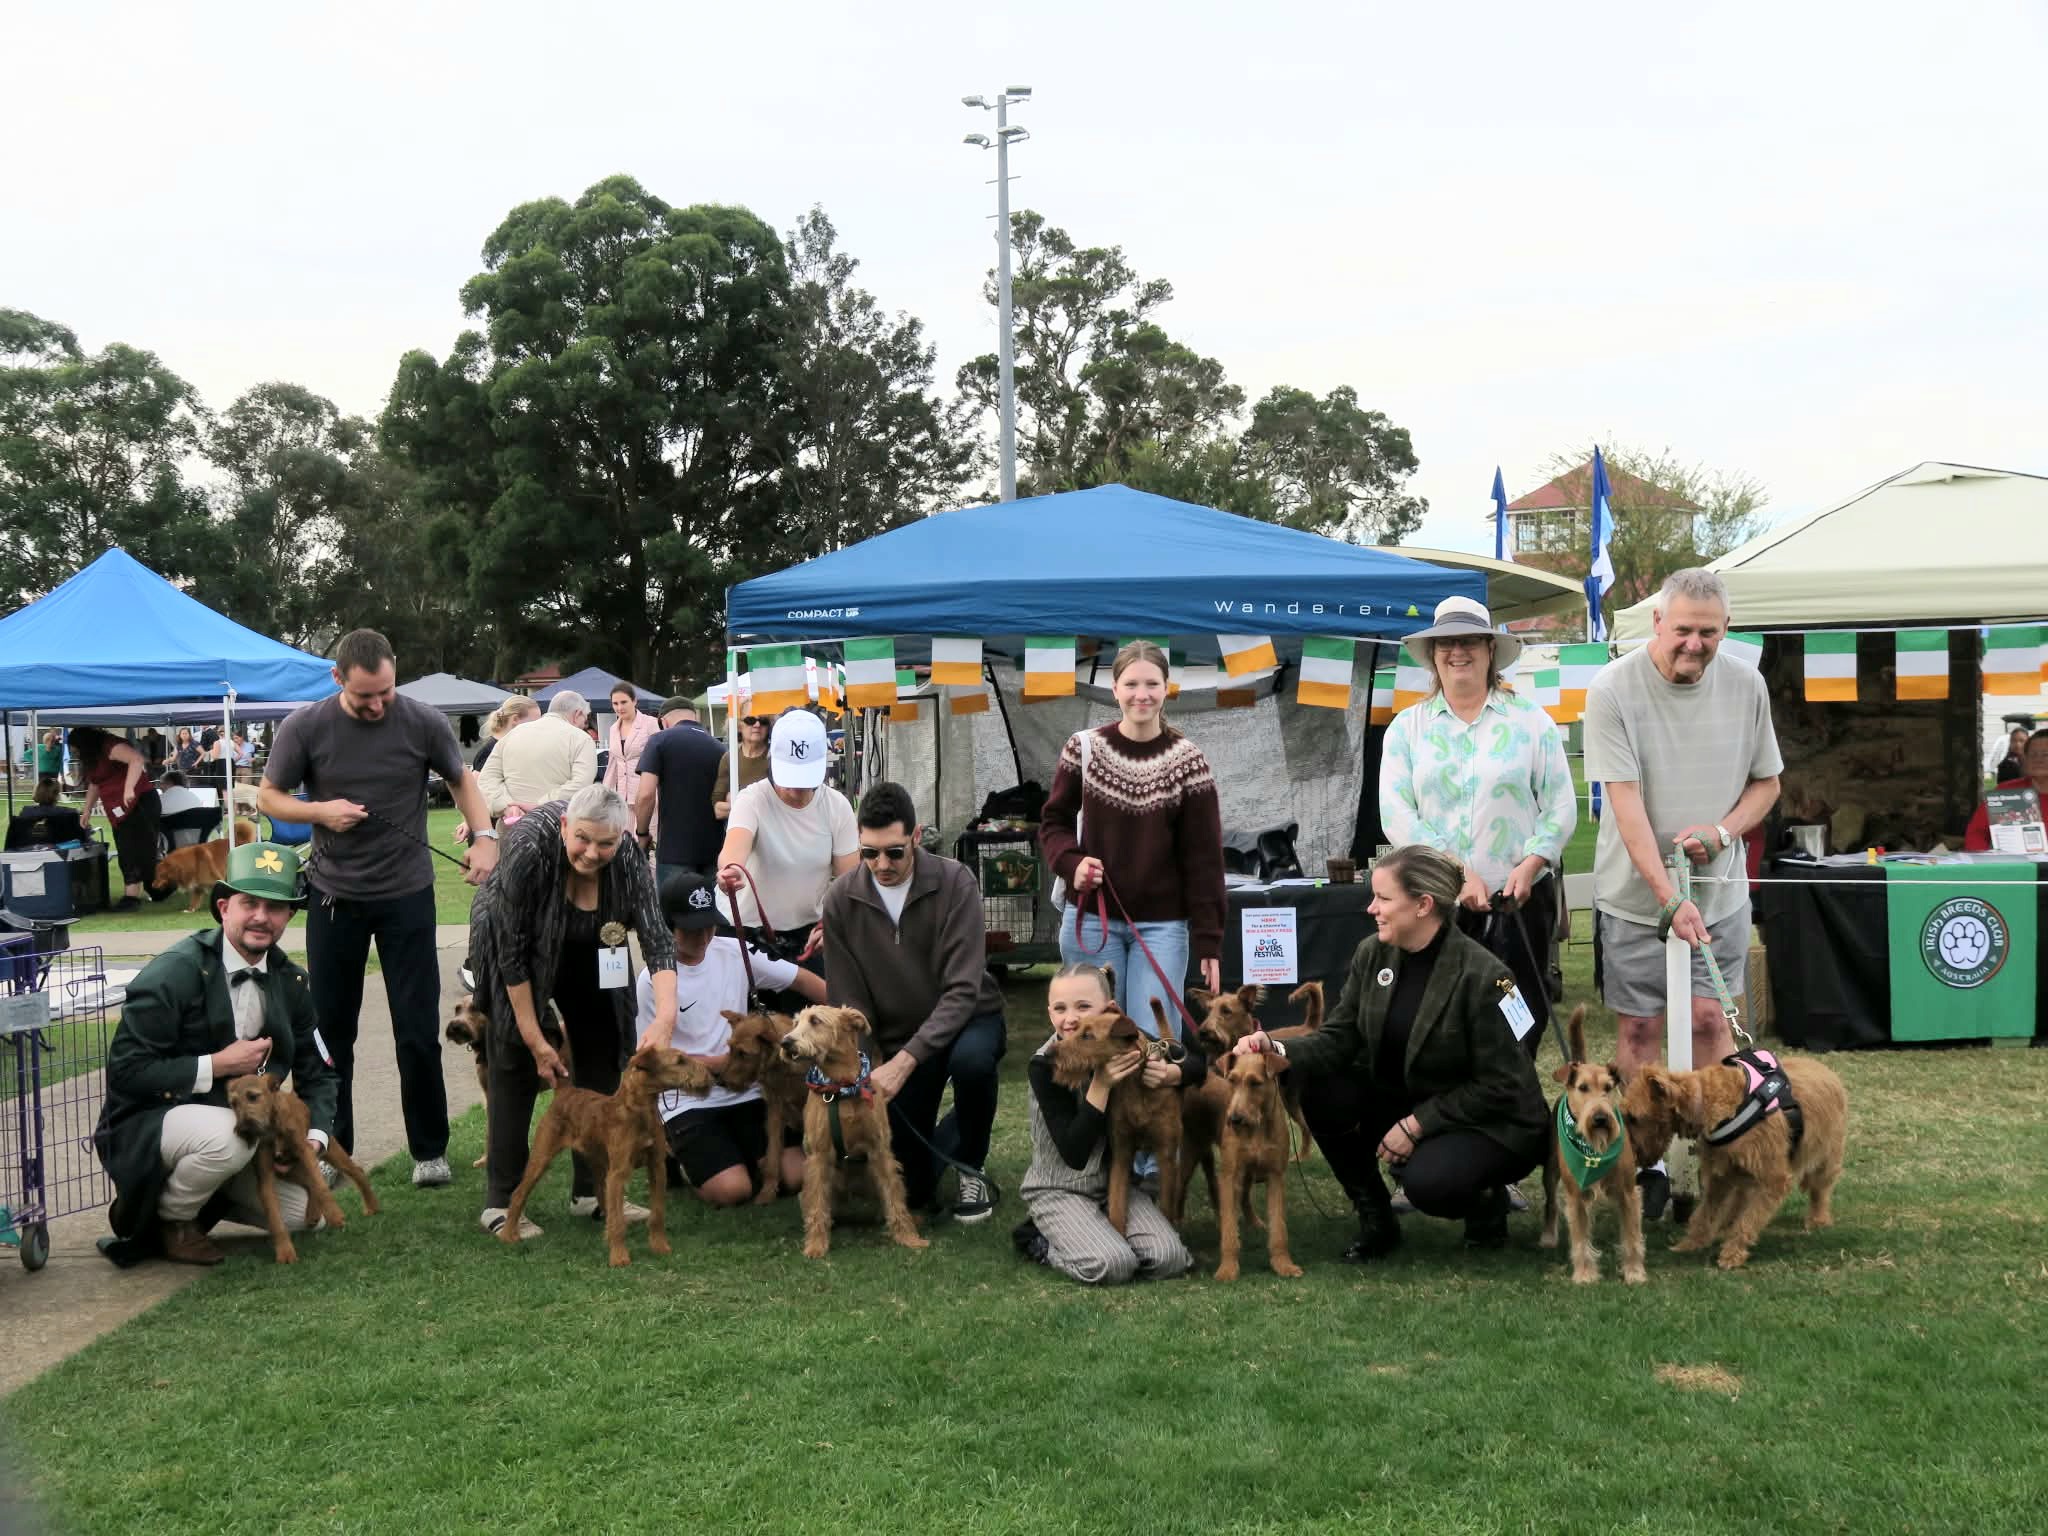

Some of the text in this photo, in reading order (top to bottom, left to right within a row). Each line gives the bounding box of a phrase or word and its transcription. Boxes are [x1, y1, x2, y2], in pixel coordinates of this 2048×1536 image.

[787, 608, 844, 619] COMPACT
[1214, 600, 1392, 616] Wanderer
[1940, 902, 1989, 919] BREEDS
[1986, 916, 2004, 947] CLUB
[1255, 944, 1283, 952] LOVERS
[606, 960, 623, 970] 112
[1940, 966, 1990, 981] AUSTRALIA
[1506, 996, 1529, 1026] 114
